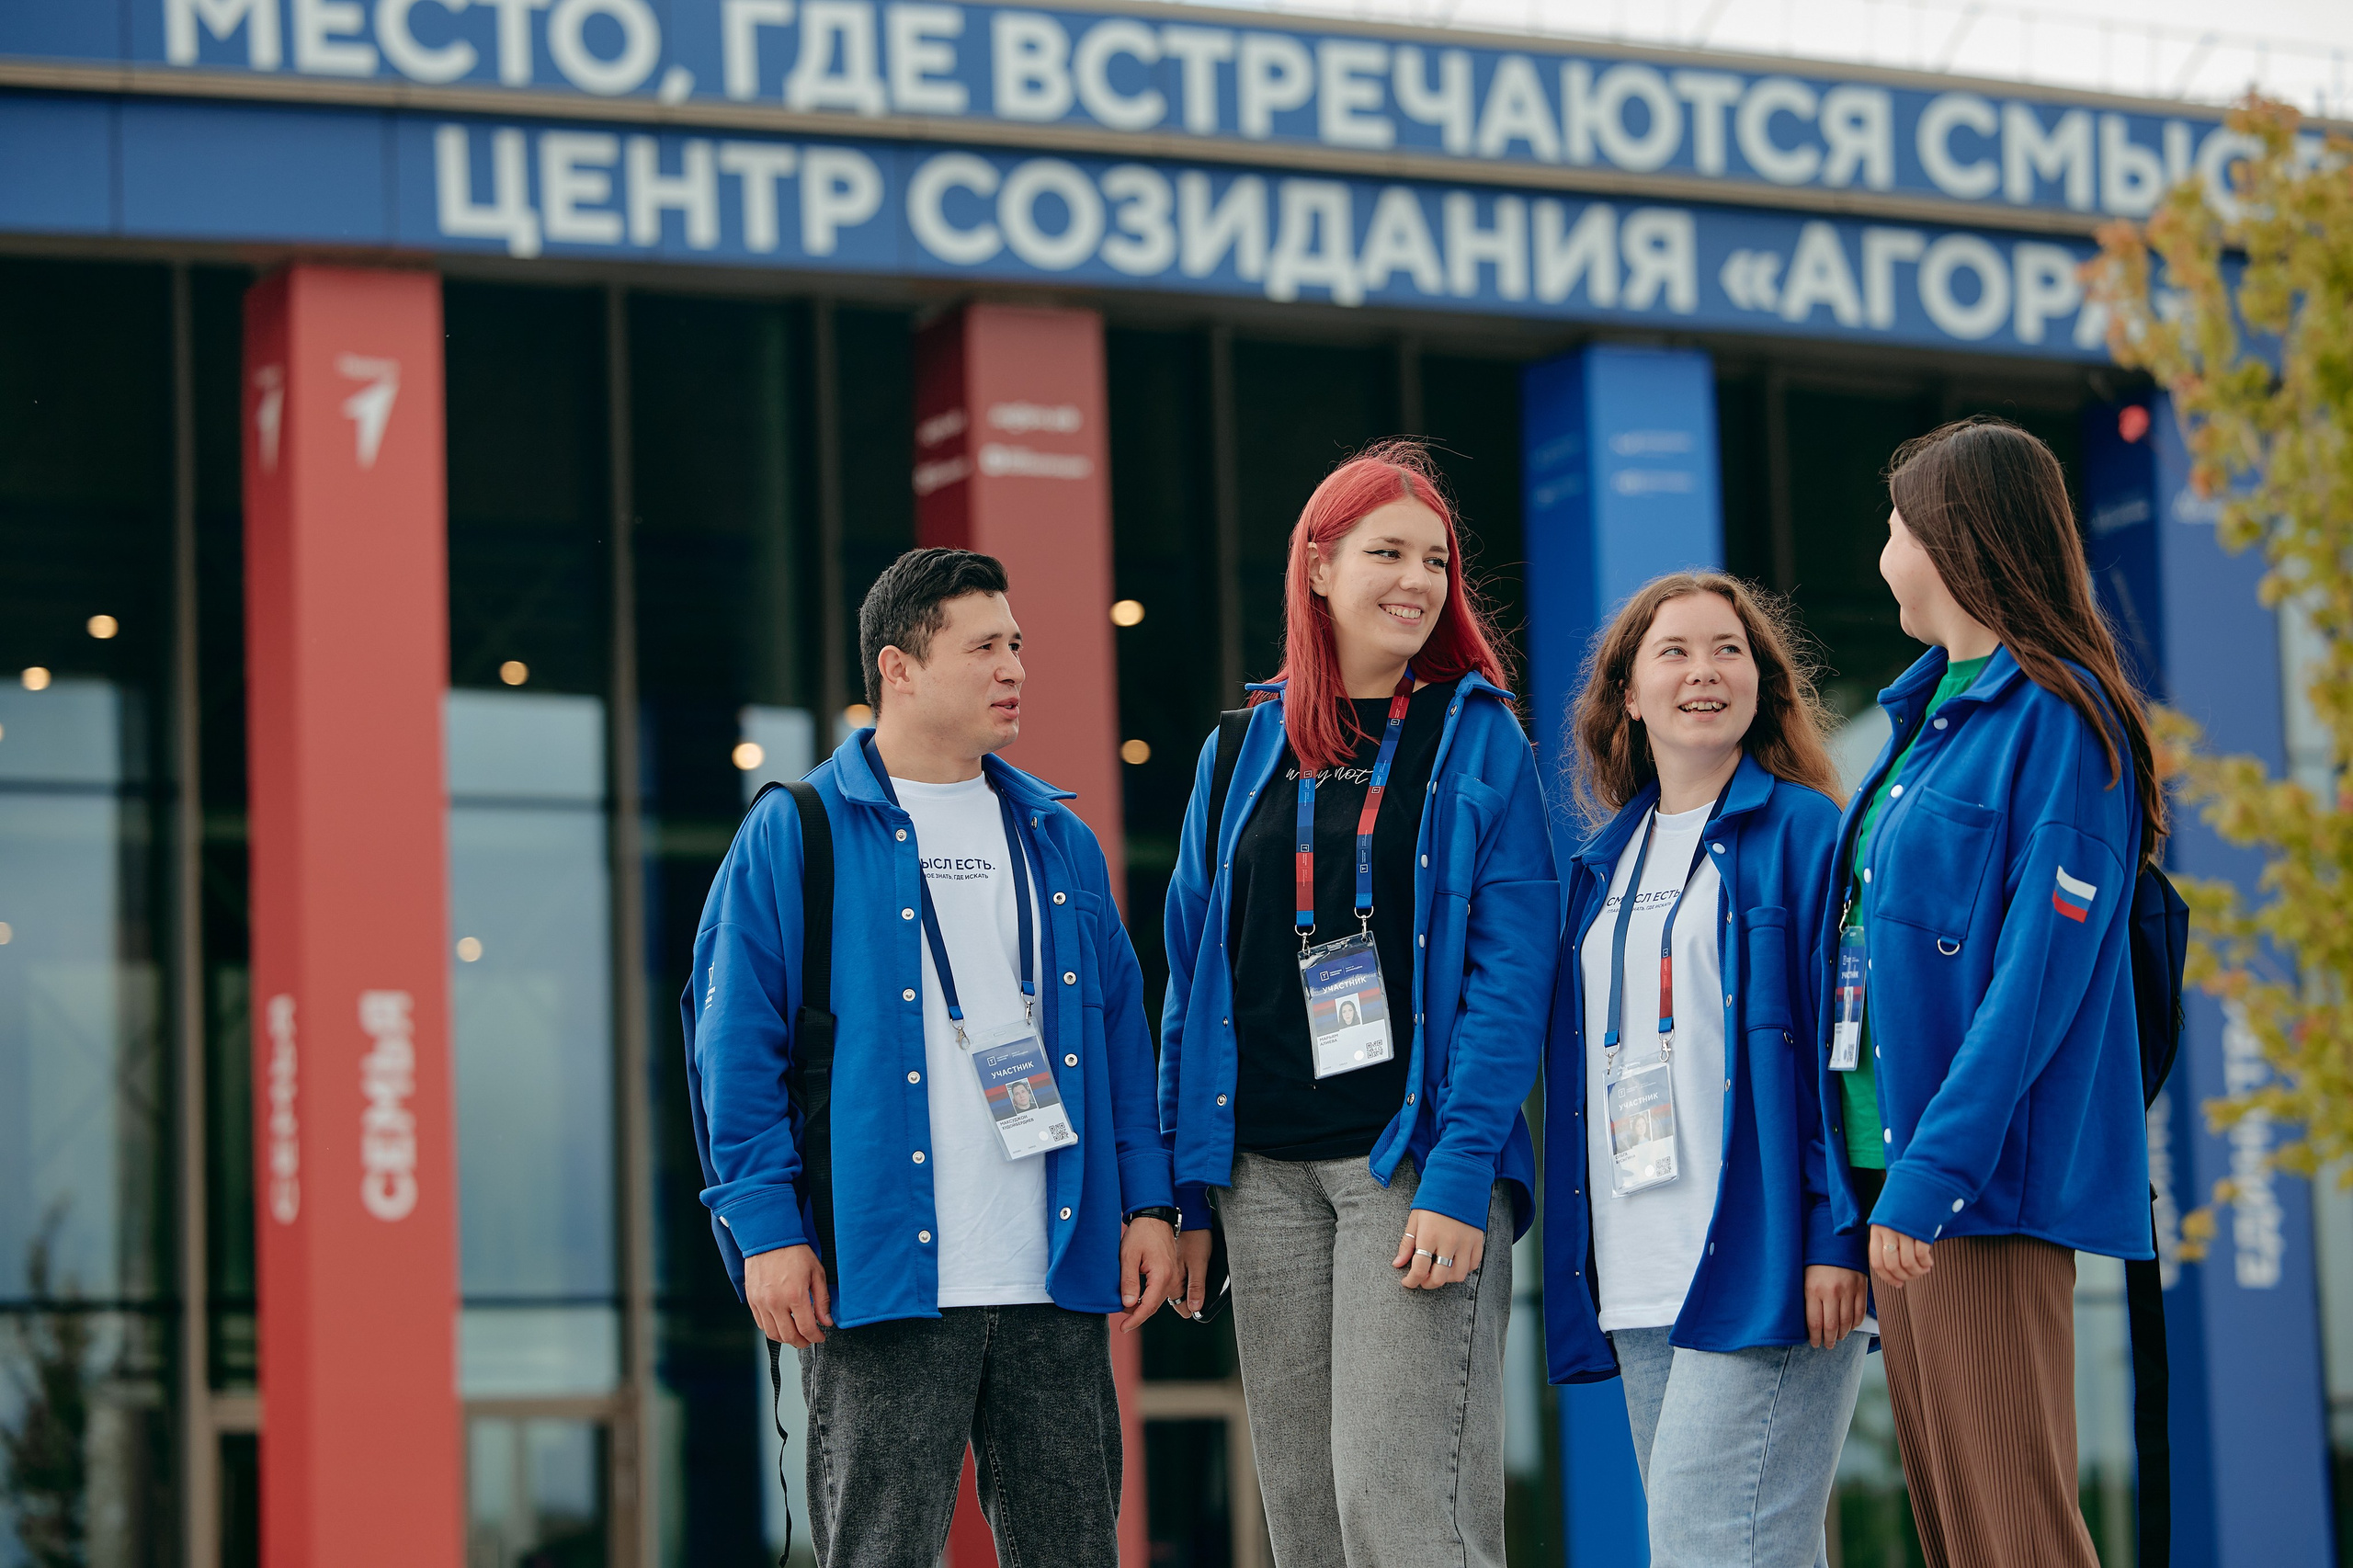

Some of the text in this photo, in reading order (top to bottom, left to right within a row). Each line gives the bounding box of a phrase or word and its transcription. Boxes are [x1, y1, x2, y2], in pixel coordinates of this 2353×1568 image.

[162, 0, 2339, 226] МЕСТО, ГДЕ ВСТРЕЧАЮТСЯ СМЫС
[434, 123, 885, 259] ЦЕНТР
[906, 152, 1699, 315] СОЗИДАНИЯ
[1285, 767, 1333, 790] wy
[920, 858, 996, 870] ЫСЛ ЕСТЬ.
[965, 872, 989, 881] ИСКАТЬ
[1606, 892, 1653, 907] СМСЛ
[1323, 975, 1368, 994] УЧАСТНИК
[991, 1060, 1035, 1080] УЧАСТНИК
[358, 987, 420, 1224] СЕМЬЯ
[1618, 1092, 1659, 1111] УЧАСТНИК
